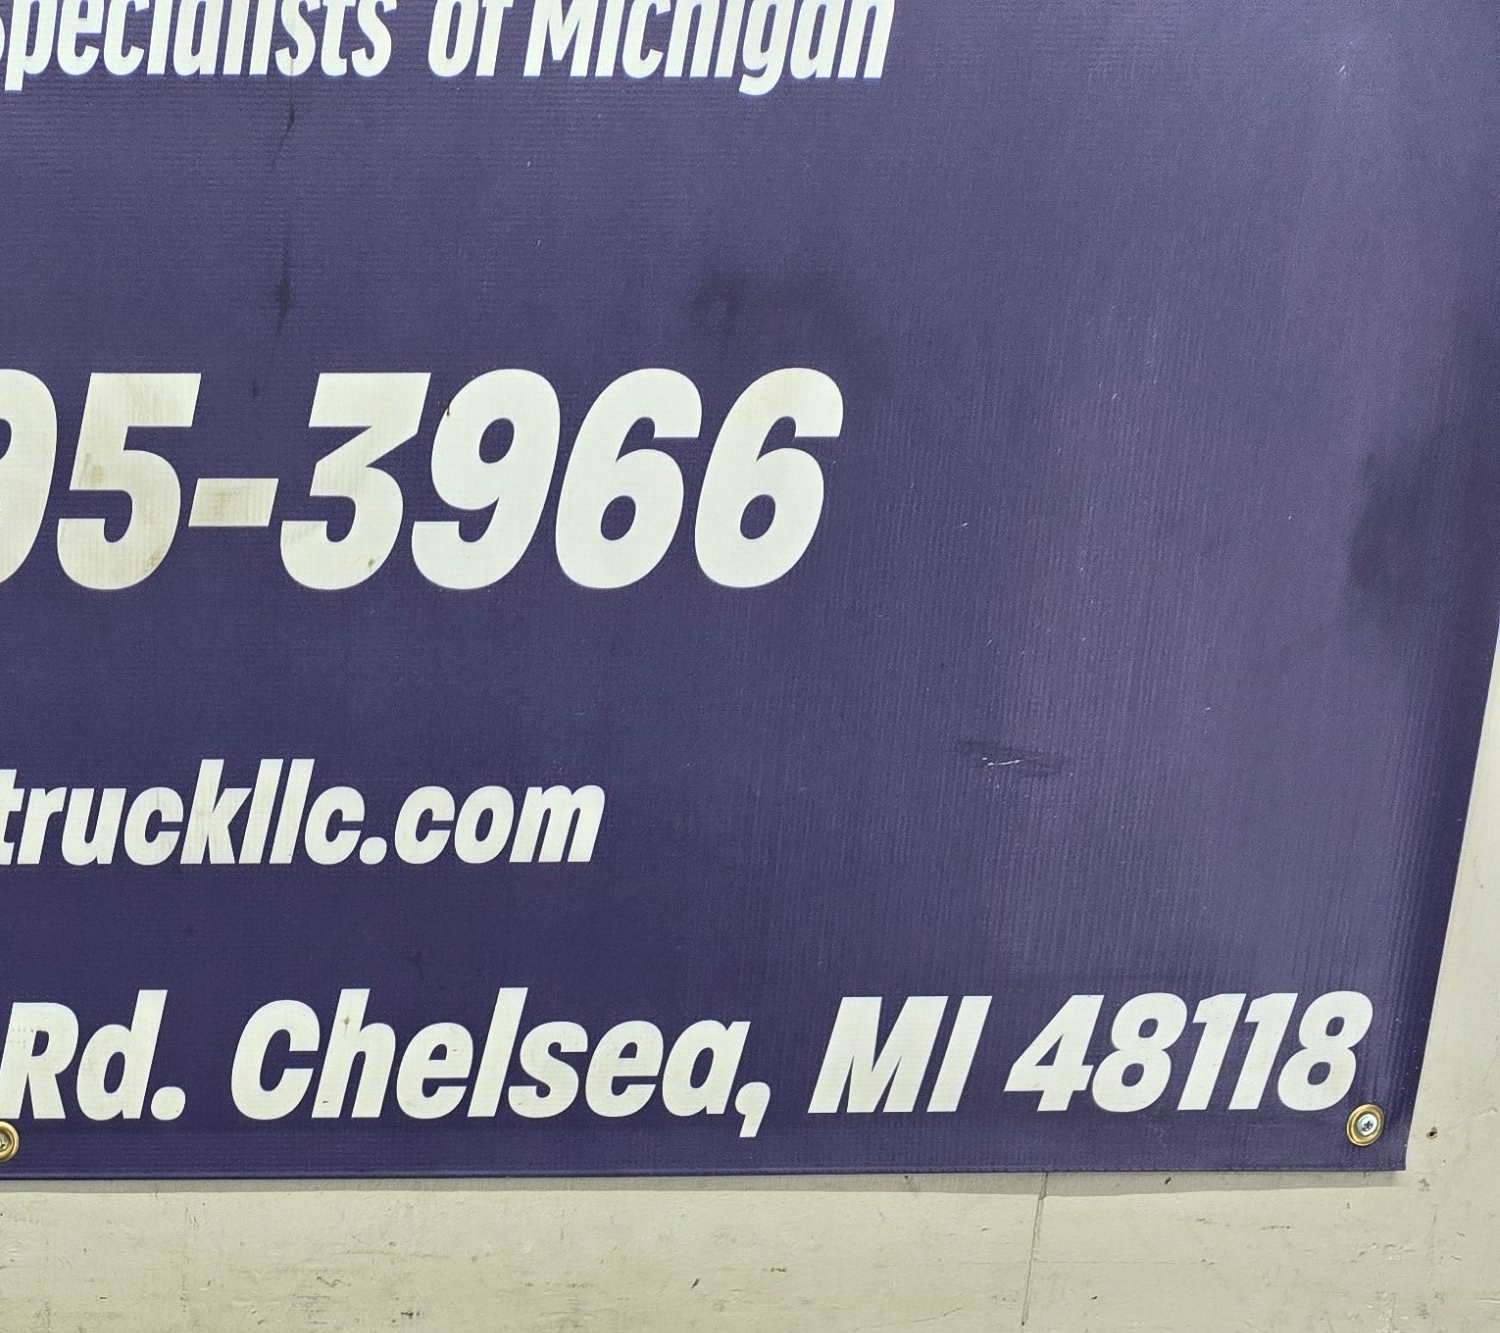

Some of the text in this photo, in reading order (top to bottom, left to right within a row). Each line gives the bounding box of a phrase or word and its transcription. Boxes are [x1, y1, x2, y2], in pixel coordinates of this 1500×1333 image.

[427, 0, 515, 78] of
[522, 0, 896, 97] Michigan
[231, 986, 771, 1138] Chelsea,
[807, 995, 993, 1114] MI
[1003, 990, 1374, 1113] 48118
